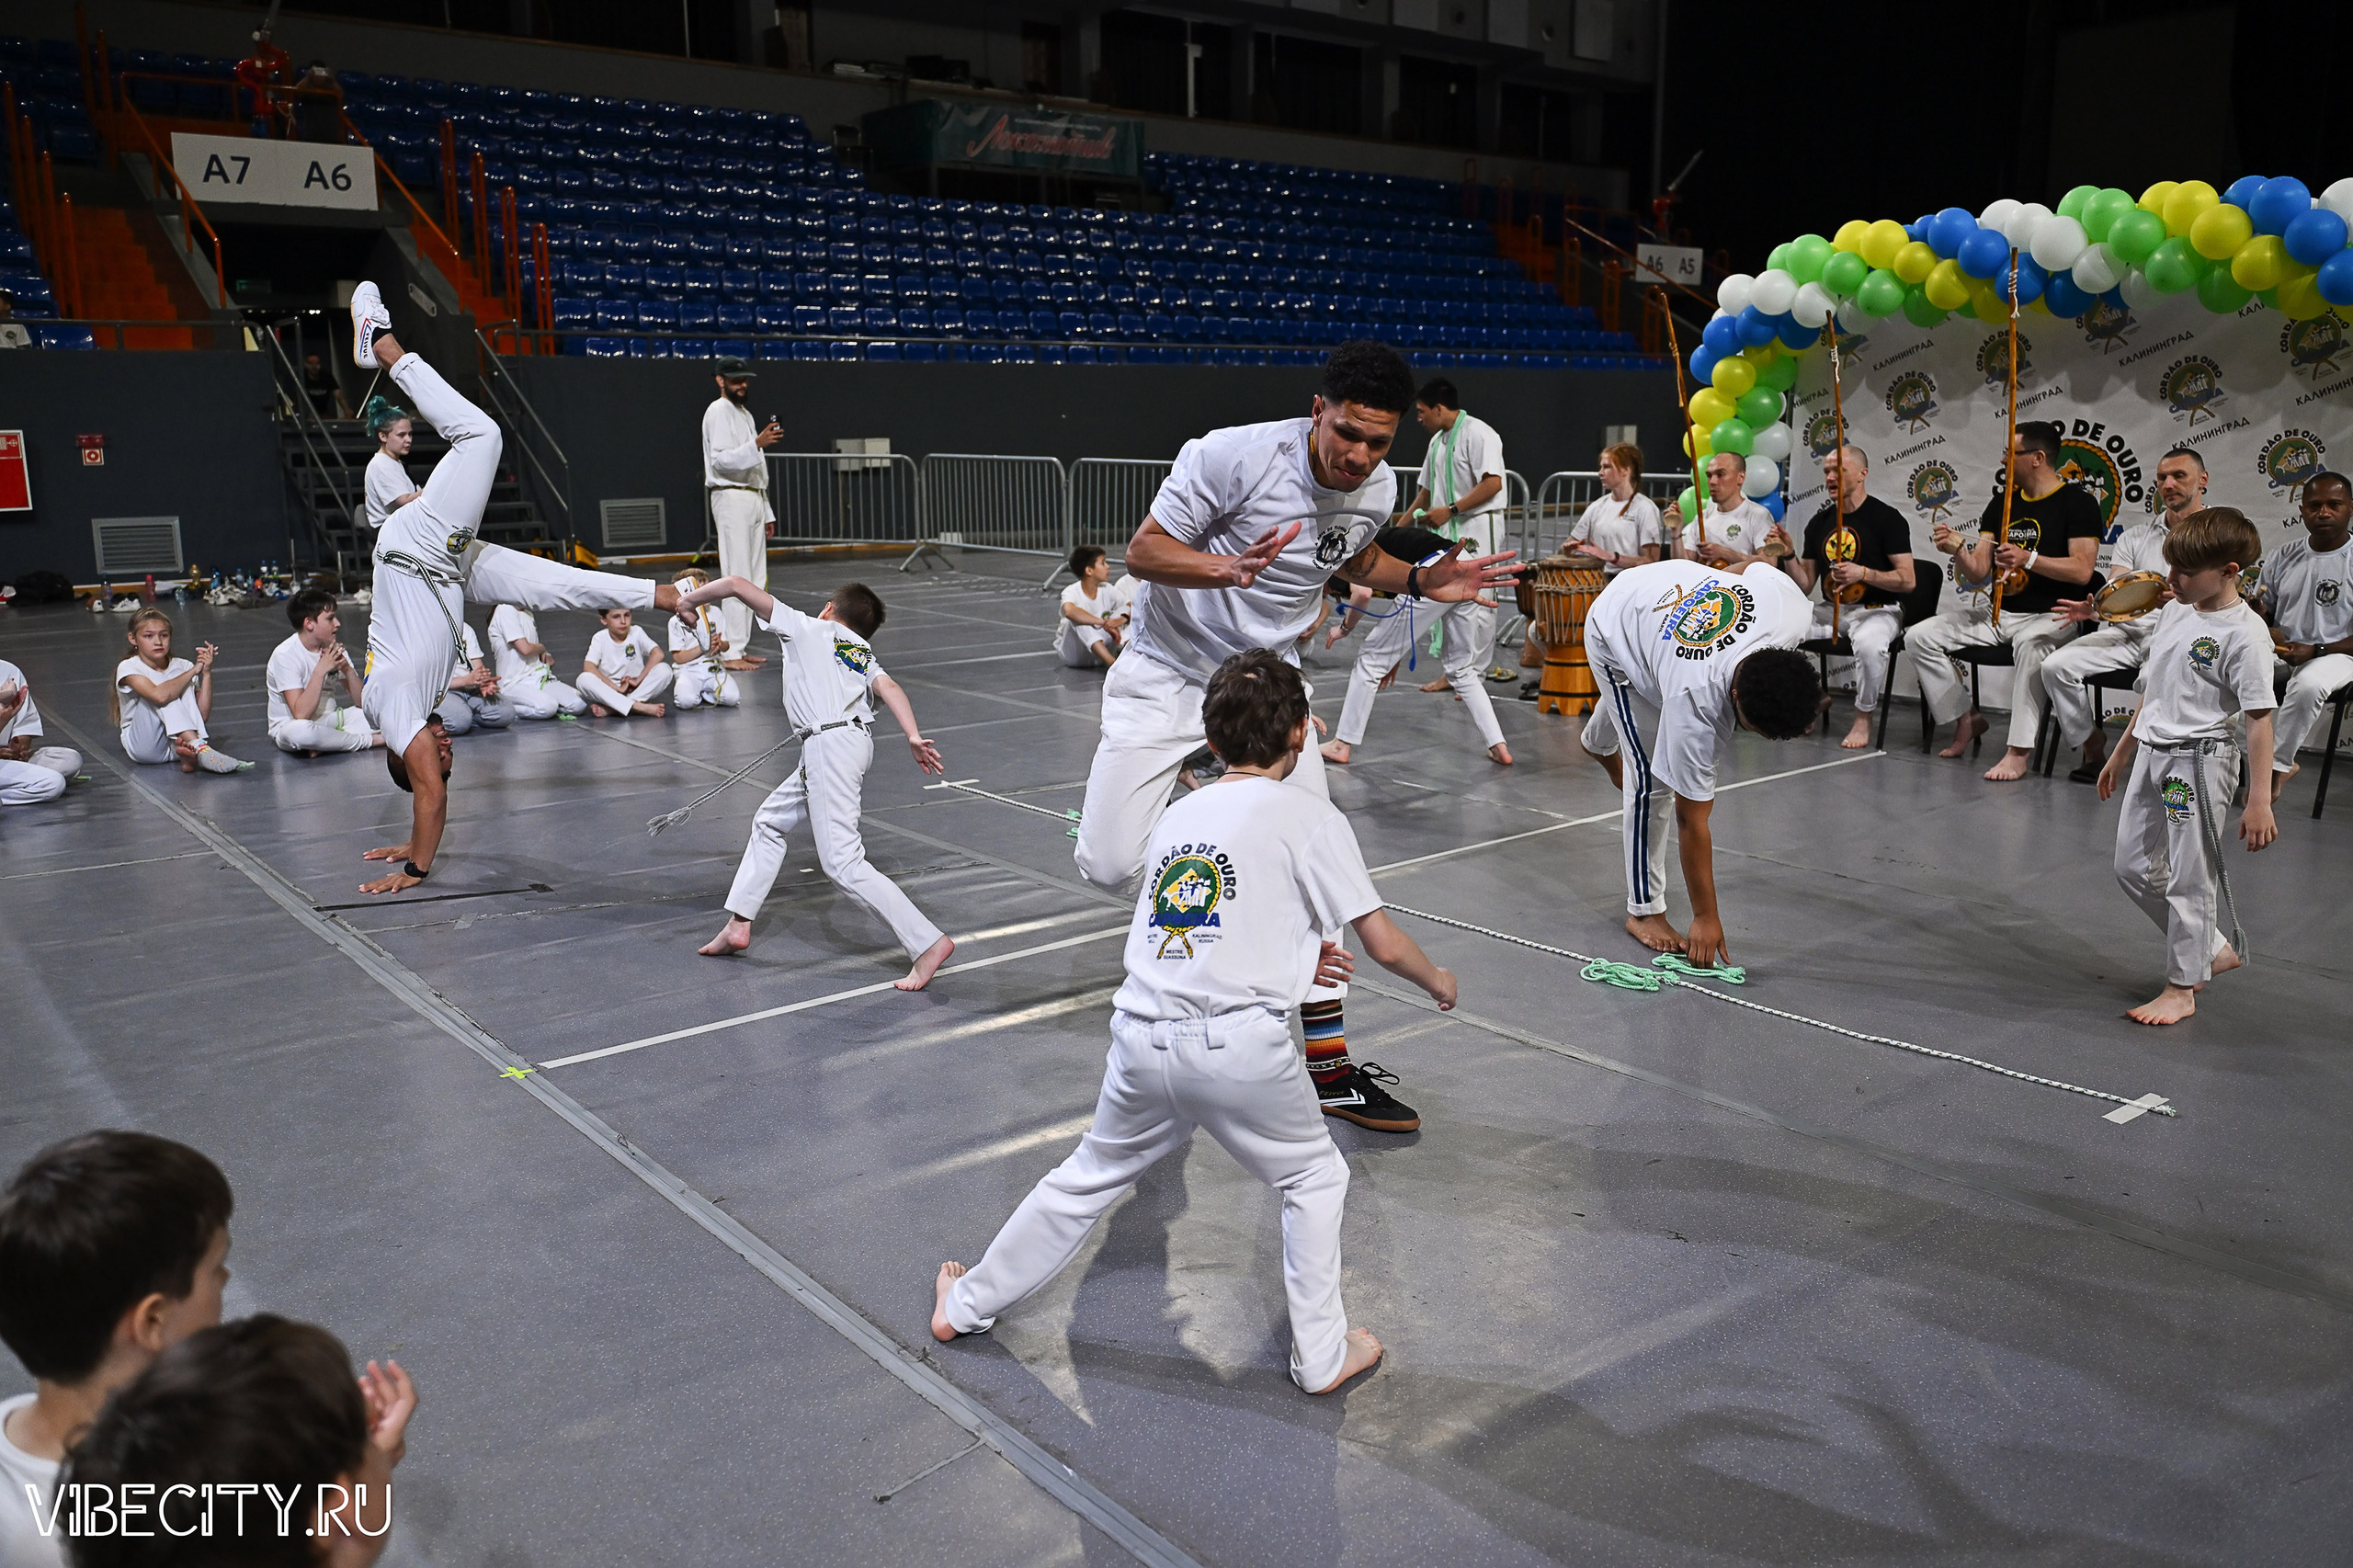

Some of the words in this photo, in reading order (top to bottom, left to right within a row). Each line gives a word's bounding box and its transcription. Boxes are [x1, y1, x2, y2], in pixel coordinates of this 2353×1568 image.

[1872, 339, 1934, 372] КАЛИНИНГРАД
[2119, 330, 2194, 368] КАЛИНИНГРАД
[1904, 370, 1915, 379] DE
[1918, 371, 1937, 392] OURO
[2185, 355, 2198, 364] DE
[2200, 356, 2222, 379] OURO
[1793, 387, 1829, 409] НИНГРАД
[1995, 386, 2063, 419] КАИНИНГРАД
[2295, 376, 2353, 406] КАЛИНИН
[2172, 417, 2250, 450] КАЛИНИНГРАД
[2284, 428, 2299, 437] DE
[2301, 430, 2325, 454] OURO
[1884, 435, 1946, 465] КАЛИНИНГРАД
[2072, 418, 2106, 442] DE
[2106, 435, 2143, 503] OURO
[1927, 460, 1938, 468] DE
[1939, 460, 1958, 482] OURO
[1788, 483, 1828, 505] АЛИНИНГР
[2144, 479, 2158, 514] CORD
[1947, 556, 1956, 581] CORD
[1662, 580, 1719, 641] CAPOEIRA
[1731, 585, 1756, 633] CORDÃO
[1676, 646, 1712, 660] OURO
[1716, 634, 1736, 652] DE
[1148, 843, 1192, 900] CORDÃO
[1196, 843, 1217, 857] DE
[1215, 853, 1237, 901] OURO
